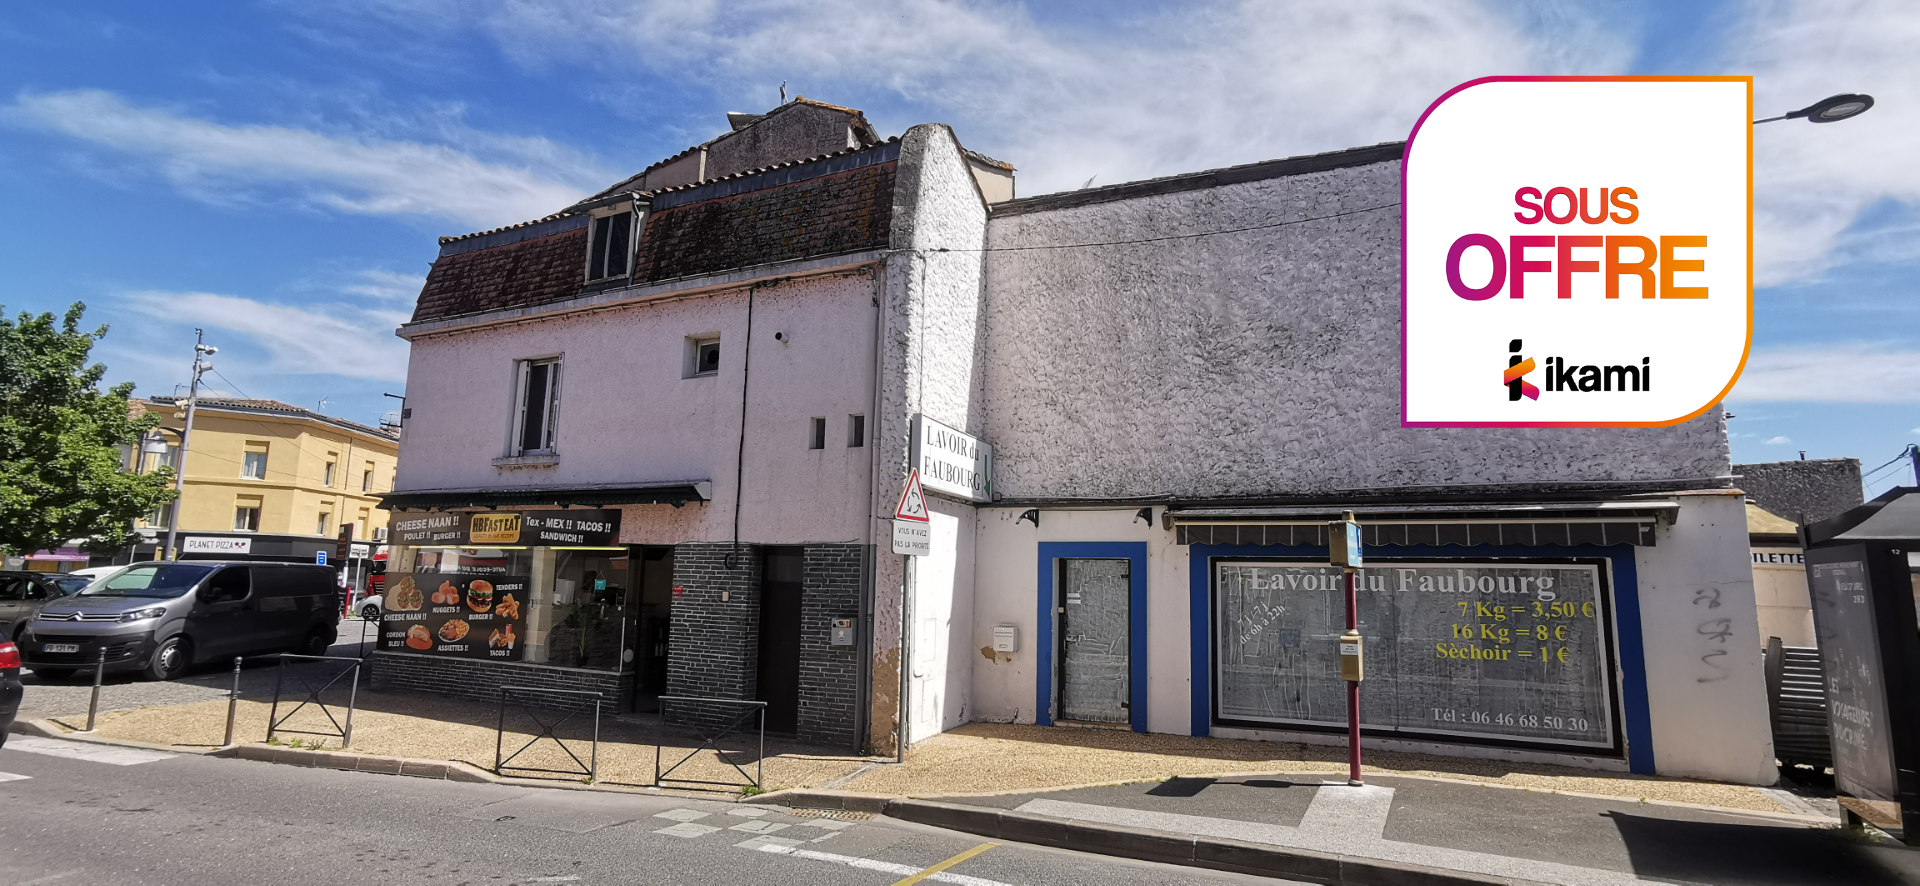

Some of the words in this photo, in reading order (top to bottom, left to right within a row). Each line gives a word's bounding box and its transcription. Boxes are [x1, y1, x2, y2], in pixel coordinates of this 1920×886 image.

[927, 425, 967, 457] LAVOIR
[969, 442, 980, 461] du
[924, 455, 981, 491] FAUBOURG
[396, 519, 427, 531] CHEESE
[428, 516, 451, 528] NAAN
[526, 516, 540, 527] Tex
[545, 518, 565, 529] MEX
[576, 521, 603, 532] TACOS
[898, 527, 910, 535] VOUS
[189, 540, 214, 549] PLANET
[216, 541, 233, 549] PIZZA
[403, 532, 425, 541] POULET
[433, 532, 456, 540] BURGER
[540, 531, 577, 542] SANDWICH
[894, 540, 903, 548] PAS
[1250, 568, 1342, 591] Lavoir
[1354, 569, 1386, 592] du
[1397, 569, 1556, 602] Faubourg
[384, 613, 406, 621] CHEESE
[406, 613, 422, 621] NAAN
[1267, 605, 1286, 621] 22h
[1457, 601, 1468, 617] 7
[1476, 601, 1507, 621] Kg
[1531, 601, 1575, 620] 3,50
[1581, 601, 1595, 618] €
[1451, 623, 1473, 639] 16
[1479, 623, 1511, 644] Kg
[1536, 624, 1549, 641] 8
[1555, 625, 1568, 641] €
[1540, 646, 1549, 663] 1
[1557, 647, 1571, 664] €
[1431, 707, 1456, 722] Tél
[1471, 711, 1490, 724] 06
[1495, 712, 1514, 726] 46
[1519, 714, 1538, 728] 68
[1543, 716, 1563, 730] 50
[1568, 717, 1588, 732] 30
